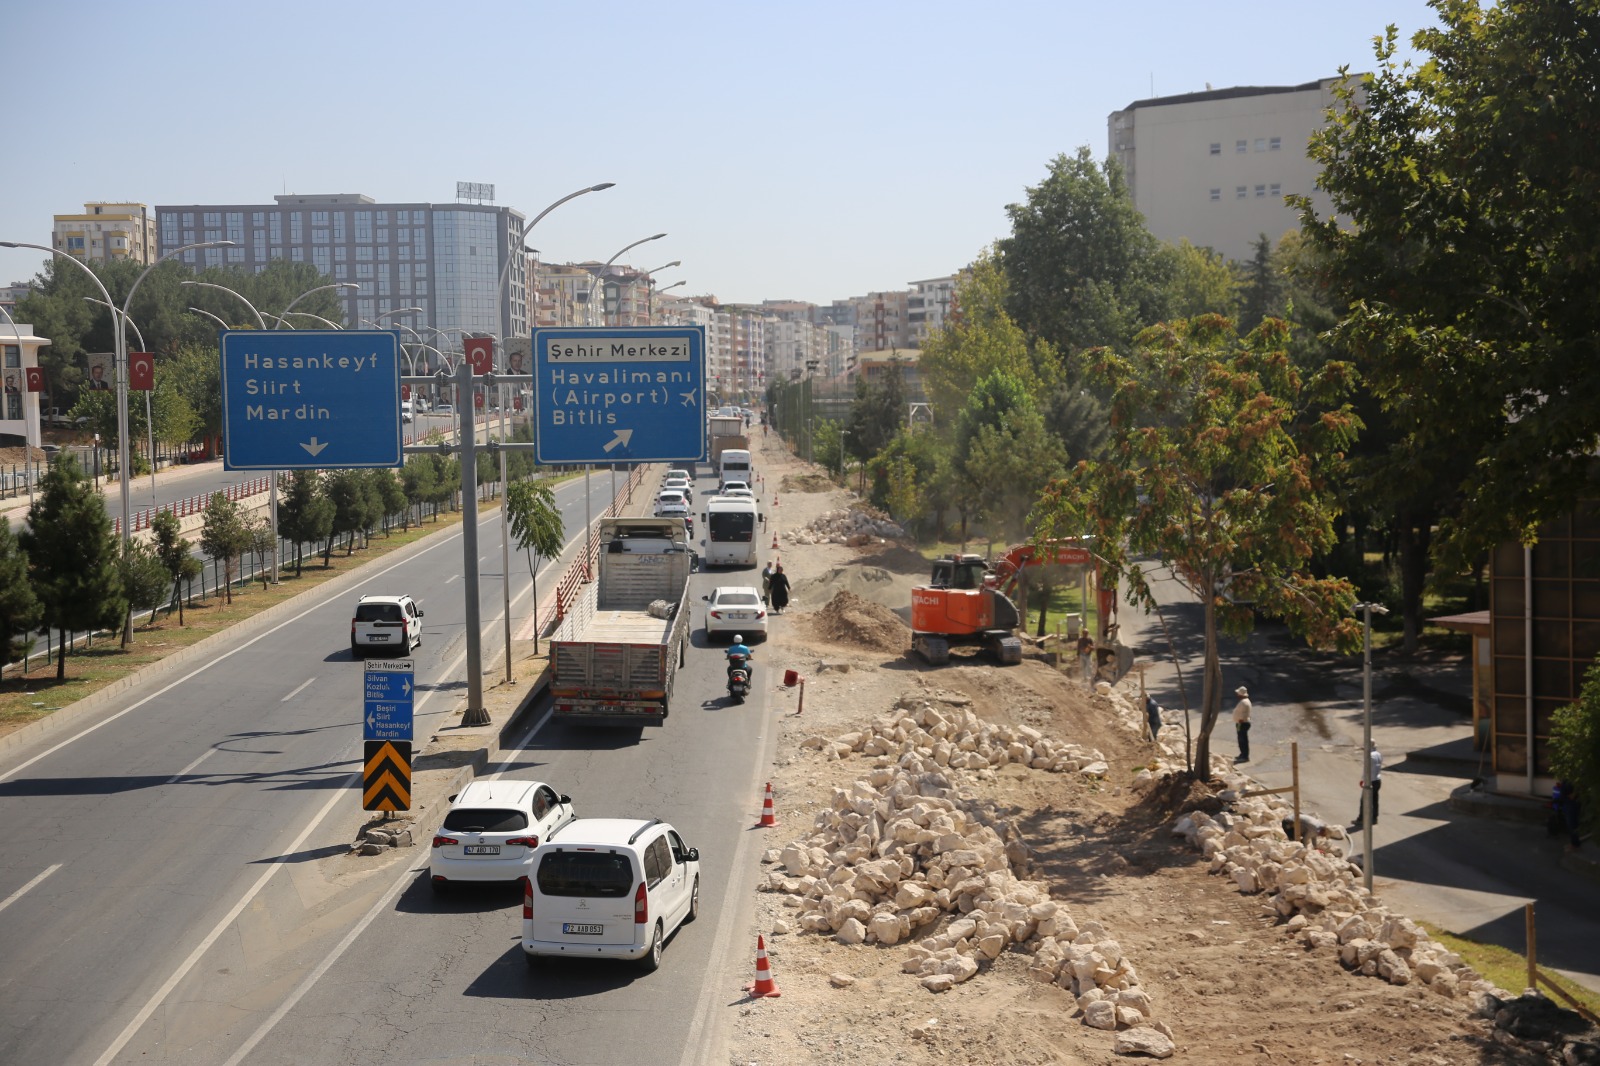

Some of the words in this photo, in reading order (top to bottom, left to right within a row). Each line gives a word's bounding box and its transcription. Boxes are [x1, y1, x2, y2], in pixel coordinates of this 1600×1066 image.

[551, 345, 603, 359] Şehir
[611, 343, 687, 357] Merkezi
[245, 353, 378, 372] Hasankeyf
[551, 369, 691, 384] Havalimanı
[245, 379, 301, 394] Siirt
[552, 386, 669, 408] (Airport)
[246, 404, 330, 421] Mardin
[553, 409, 617, 425] Bitlis
[367, 674, 388, 682] Silvan
[376, 721, 410, 731] Hasankeyf
